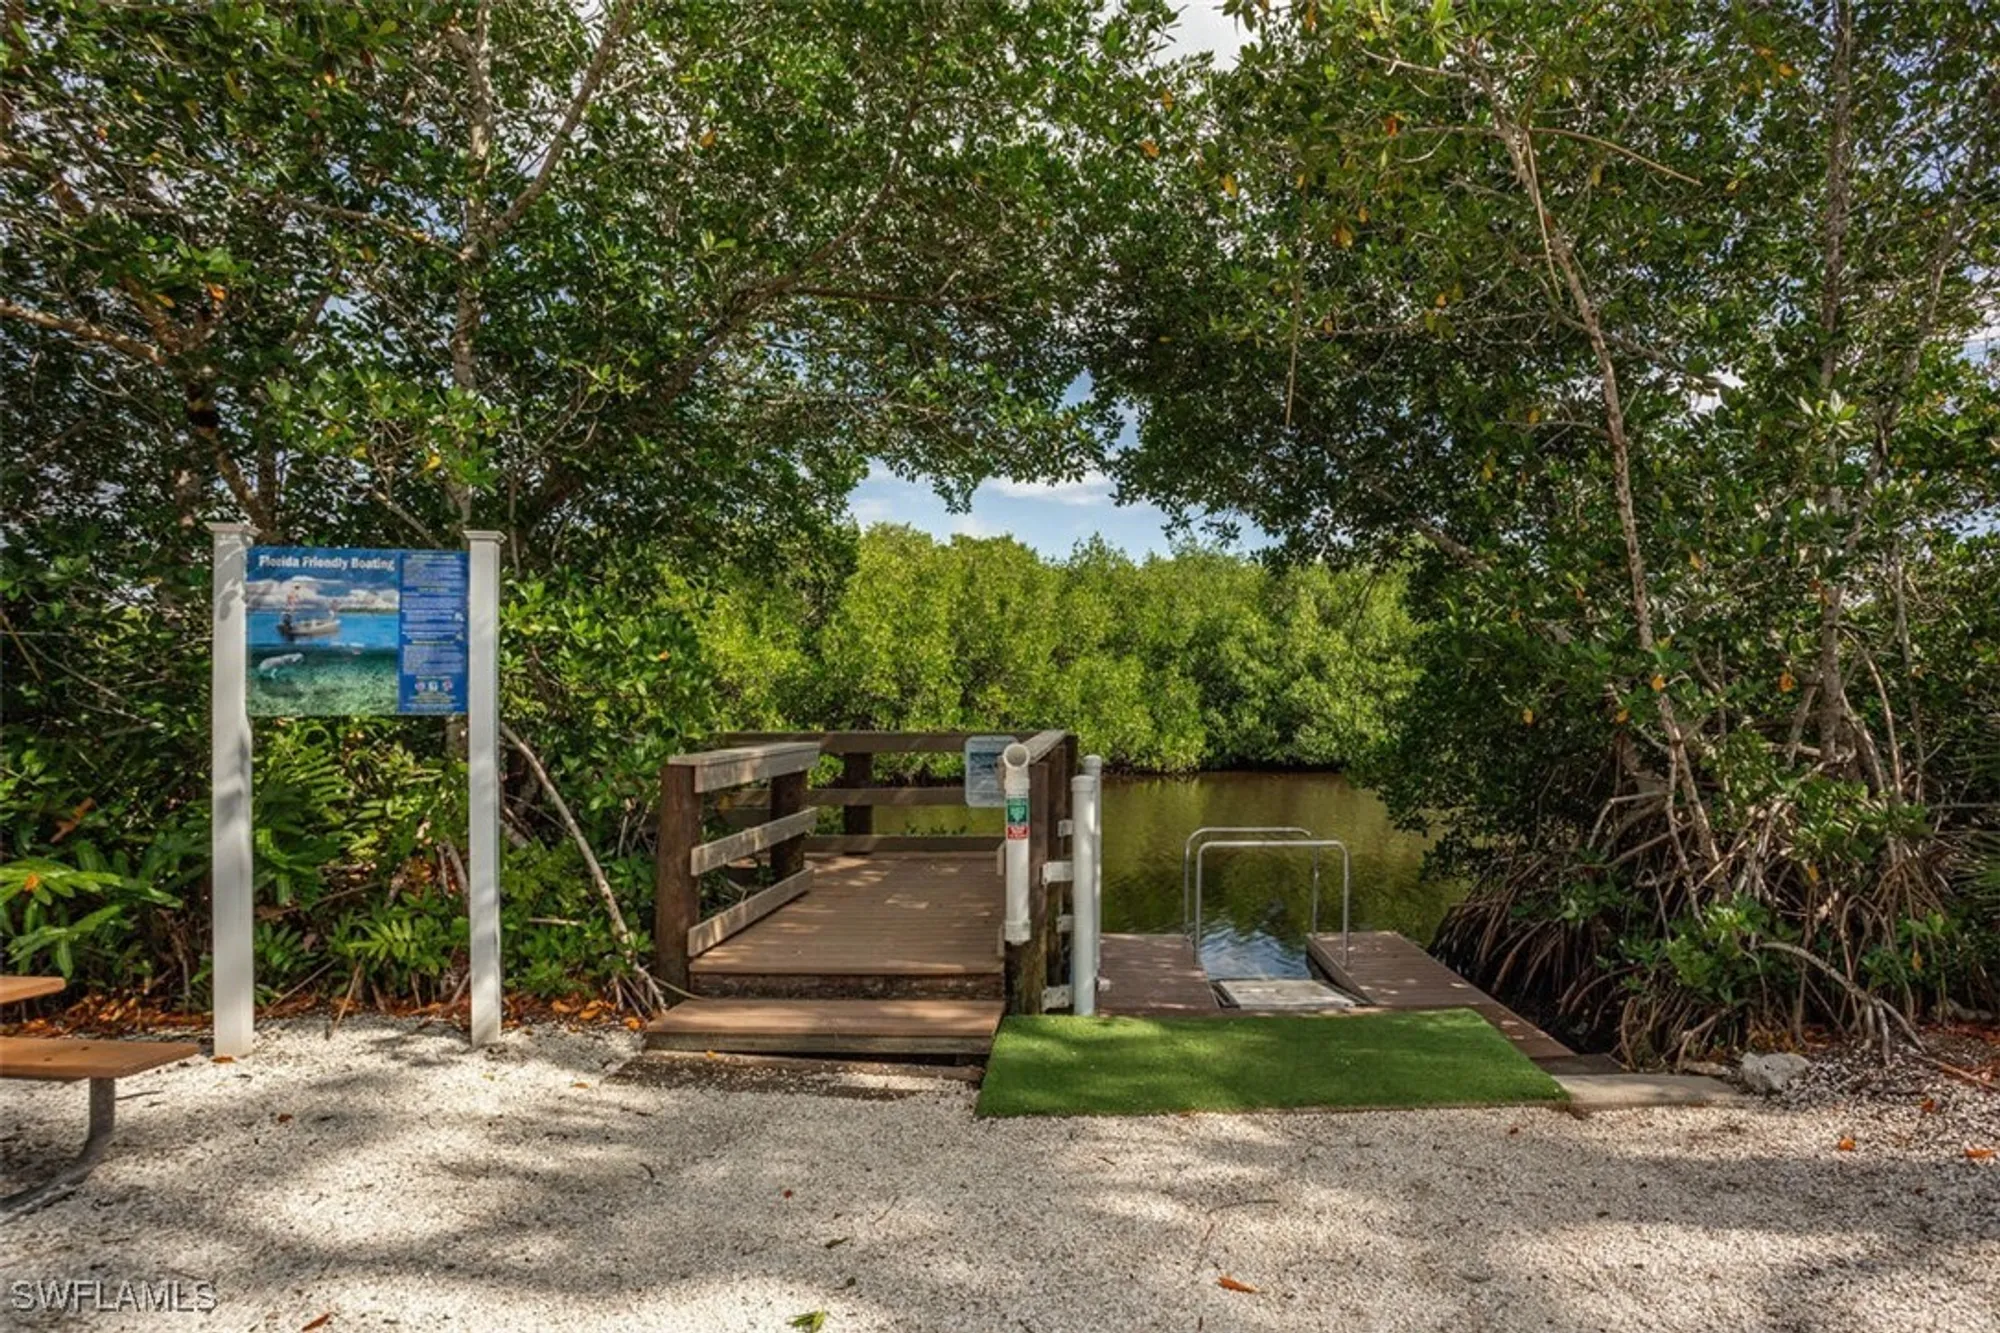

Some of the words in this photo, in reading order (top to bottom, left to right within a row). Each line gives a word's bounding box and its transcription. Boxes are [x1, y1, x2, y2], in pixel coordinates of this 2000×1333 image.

[259, 555, 300, 567] Florida
[302, 556, 348, 570] Friendly
[352, 557, 395, 571] Boating
